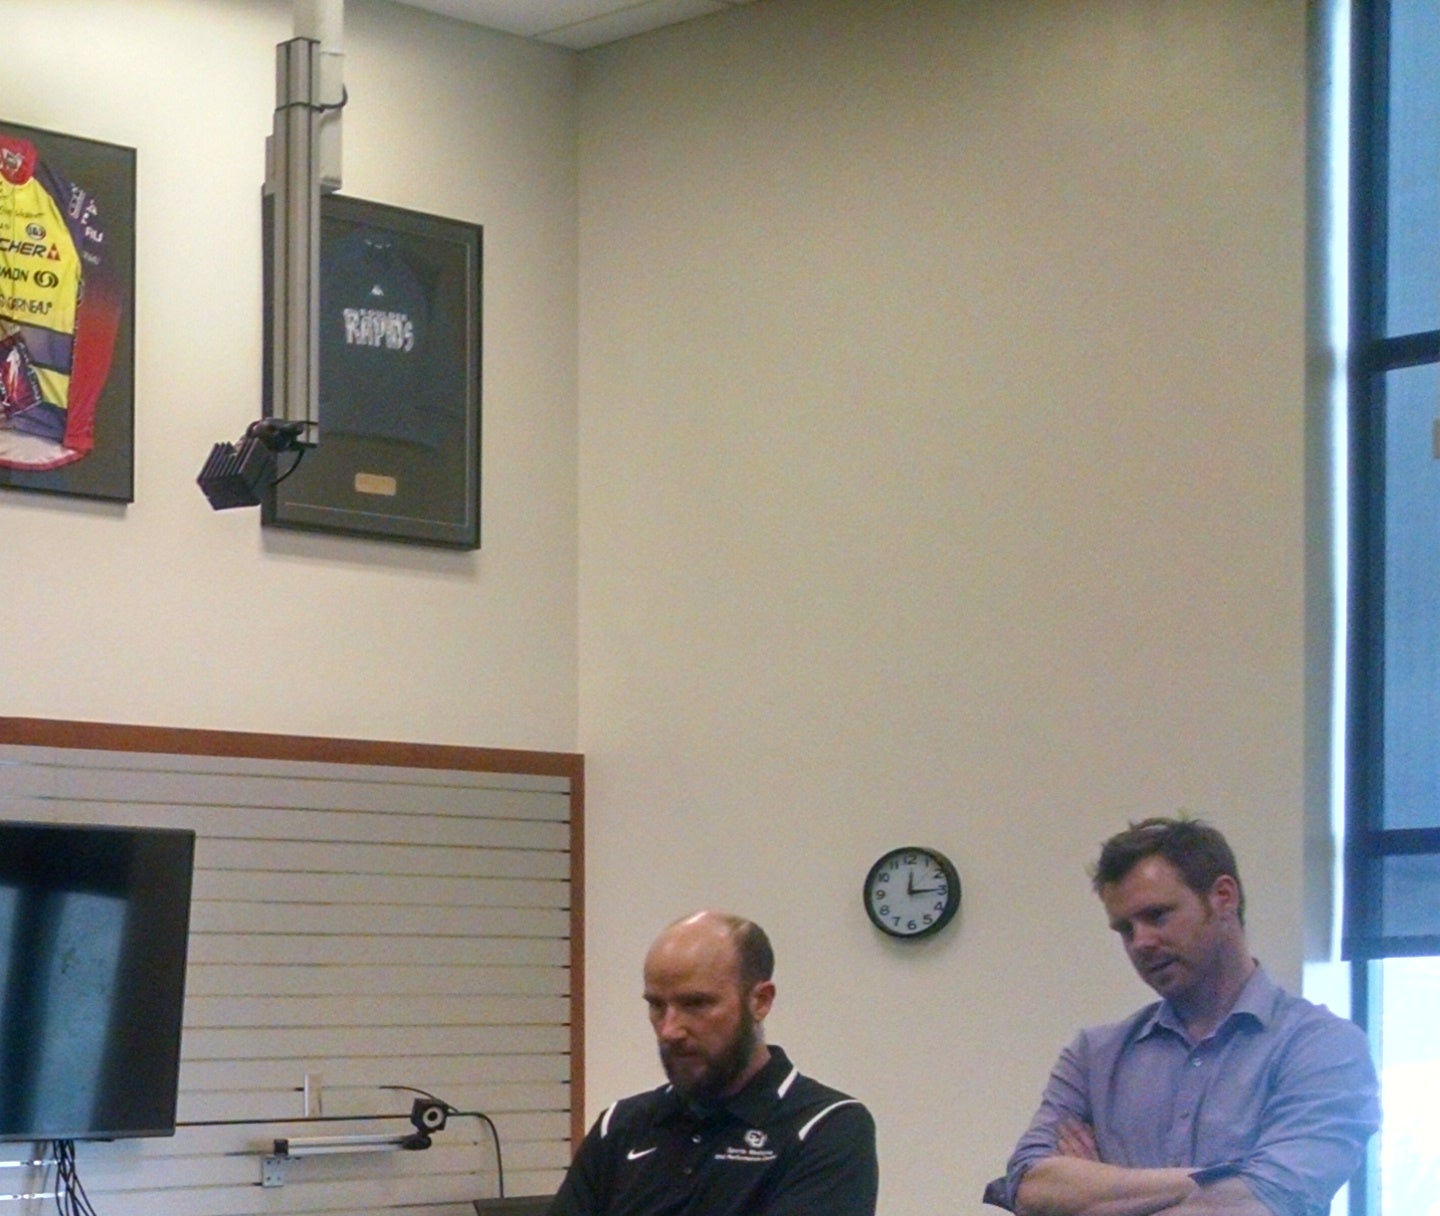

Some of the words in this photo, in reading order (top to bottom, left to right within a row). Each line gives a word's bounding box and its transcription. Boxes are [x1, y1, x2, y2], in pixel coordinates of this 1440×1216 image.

[343, 308, 414, 352] RAPIDS
[904, 855, 917, 865] 12
[878, 872, 890, 882] 10
[934, 869, 943, 878] 2
[875, 890, 885, 900] 9
[937, 885, 947, 895] 3
[879, 905, 889, 915] 8
[934, 901, 944, 911] 4
[892, 916, 900, 926] 7
[907, 919, 916, 930] 6
[923, 914, 932, 925] 5
